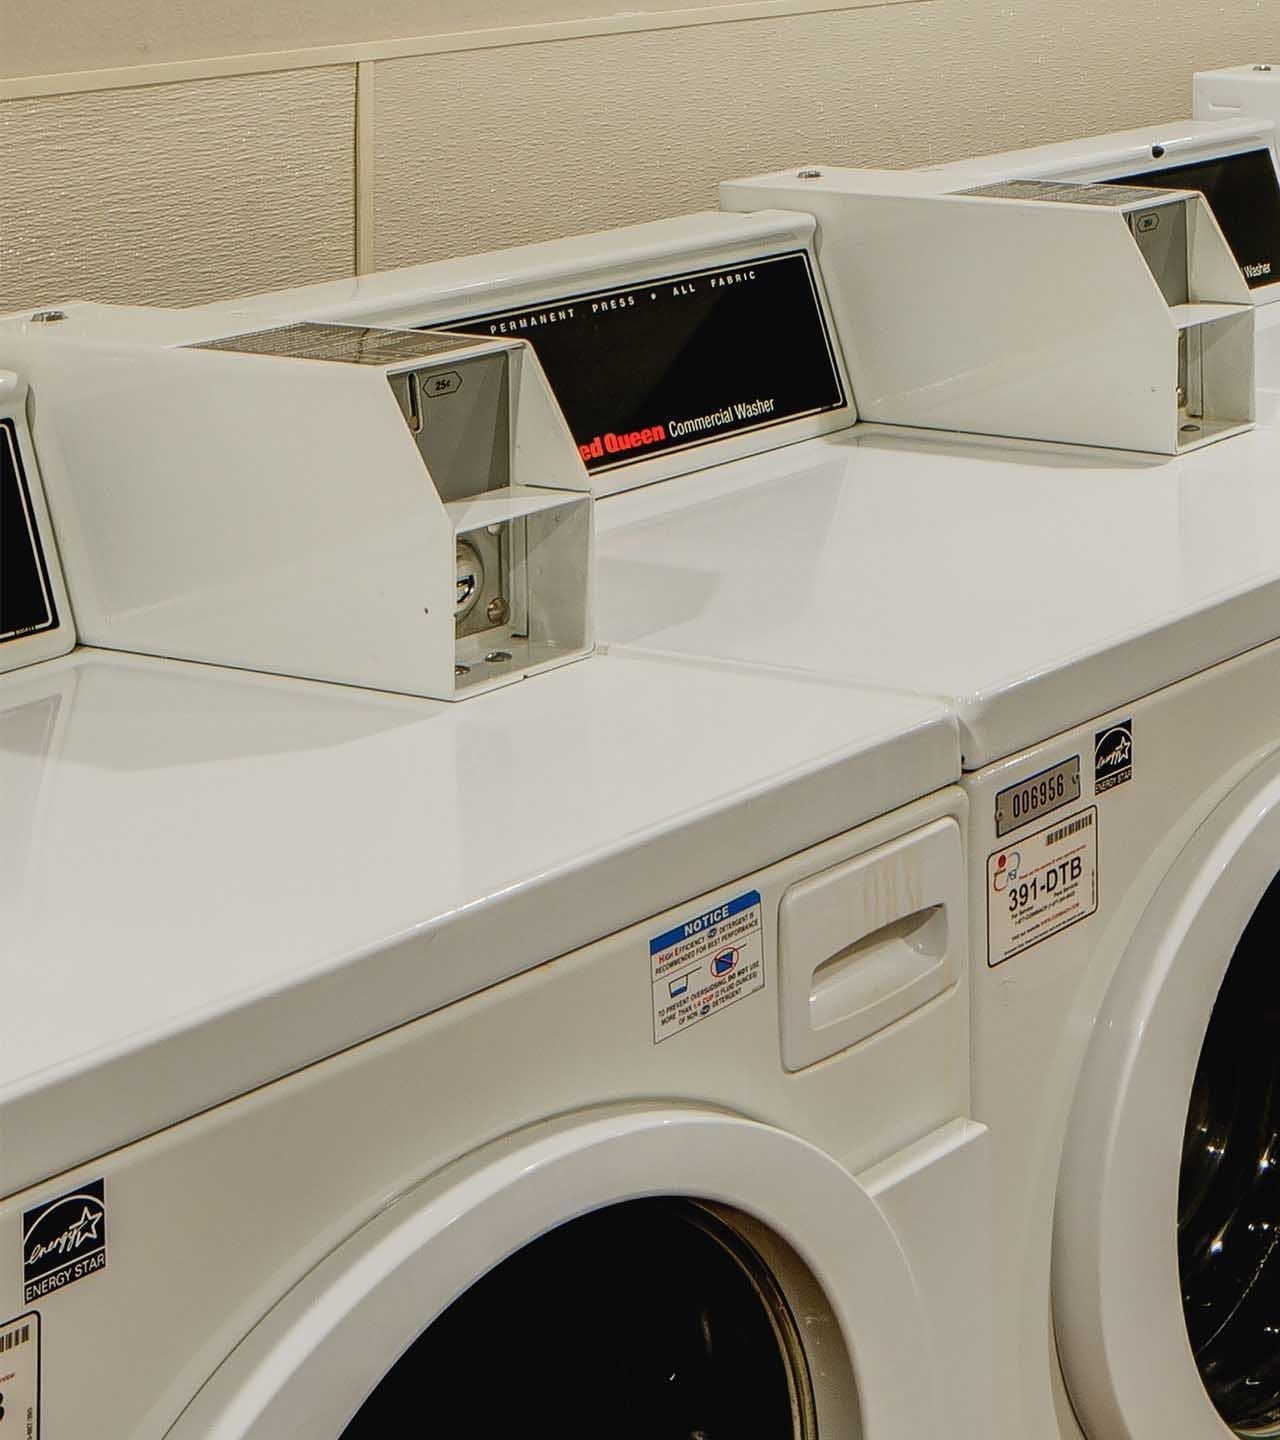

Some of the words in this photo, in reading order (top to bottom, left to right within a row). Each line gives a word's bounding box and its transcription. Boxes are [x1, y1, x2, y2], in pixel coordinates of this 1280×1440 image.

[1244, 262, 1271, 278] Washer
[490, 309, 575, 335] PERMANENT
[592, 296, 635, 313] PRESS
[673, 283, 696, 297] ALL
[711, 270, 756, 288] FABRIC
[436, 380, 450, 390] 25¢
[604, 424, 666, 453] Queen
[668, 407, 733, 438] Commercial
[733, 398, 775, 420] Washer
[1013, 773, 1064, 818] 006956
[1009, 856, 1082, 911] 391-DTB
[684, 905, 729, 937] NOTICE
[719, 915, 748, 934] DETERGENT
[656, 950, 695, 974] RECOMMENDED
[696, 946, 706, 955] FOR
[708, 940, 720, 950] BEST
[721, 918, 758, 943] PERFORMANCE
[659, 1009, 665, 1017] TO
[666, 997, 690, 1013] PREVENT
[728, 973, 736, 981] DO
[737, 966, 749, 976] NOT
[750, 960, 759, 971] USE
[679, 1017, 685, 1025] OF
[712, 988, 742, 1008] DETERGENT
[661, 1013, 675, 1025] MORE
[678, 1004, 692, 1015] THAN
[25, 1266, 72, 1302] ENERGY
[74, 1253, 105, 1276] STAR
